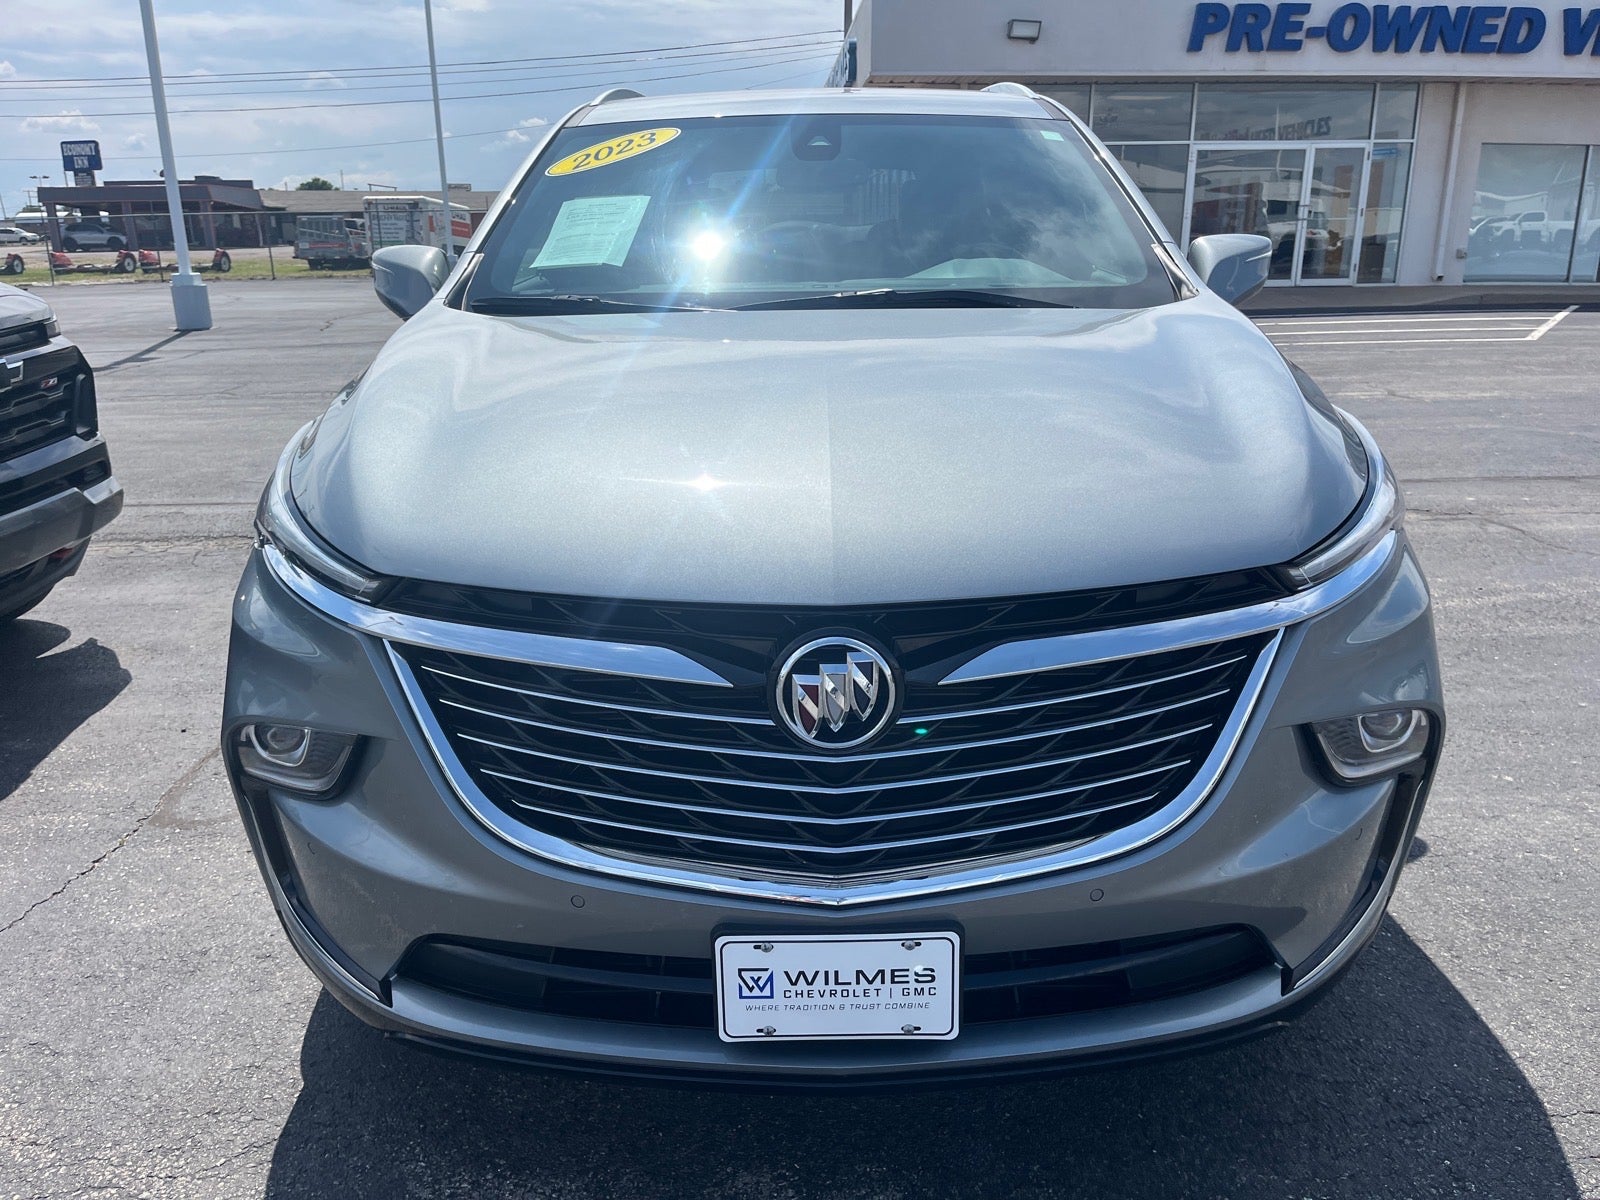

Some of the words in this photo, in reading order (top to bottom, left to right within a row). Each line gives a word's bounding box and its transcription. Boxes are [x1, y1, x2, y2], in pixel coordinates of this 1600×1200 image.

[1187, 2, 1547, 54] PRE-OWNED
[1563, 7, 1600, 56] V
[572, 132, 657, 170] 2023
[783, 967, 936, 987] WILMES
[783, 987, 882, 999] CHEVROLET
[902, 987, 937, 997] GMC
[745, 1004, 780, 1012] WHERE
[784, 1003, 835, 1012] TRADITION
[838, 1003, 846, 1011] &
[884, 1002, 931, 1010] COMBINE
